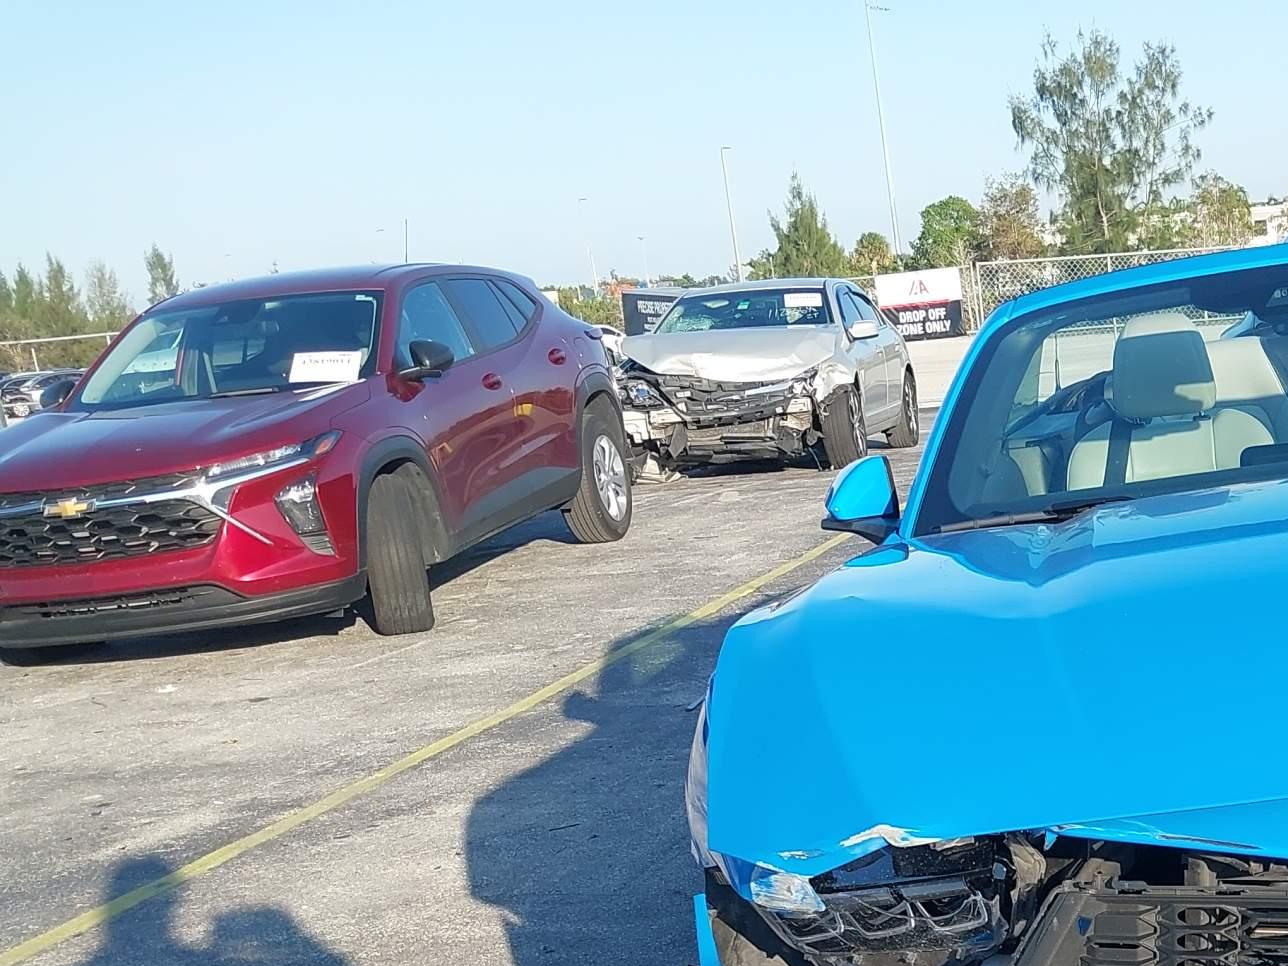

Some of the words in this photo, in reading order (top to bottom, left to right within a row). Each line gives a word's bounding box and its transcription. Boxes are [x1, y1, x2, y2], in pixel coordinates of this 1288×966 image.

[899, 310, 926, 323] DROP
[928, 307, 947, 320] OFF
[896, 323, 925, 335] ZONE
[925, 320, 951, 333] ONLY
